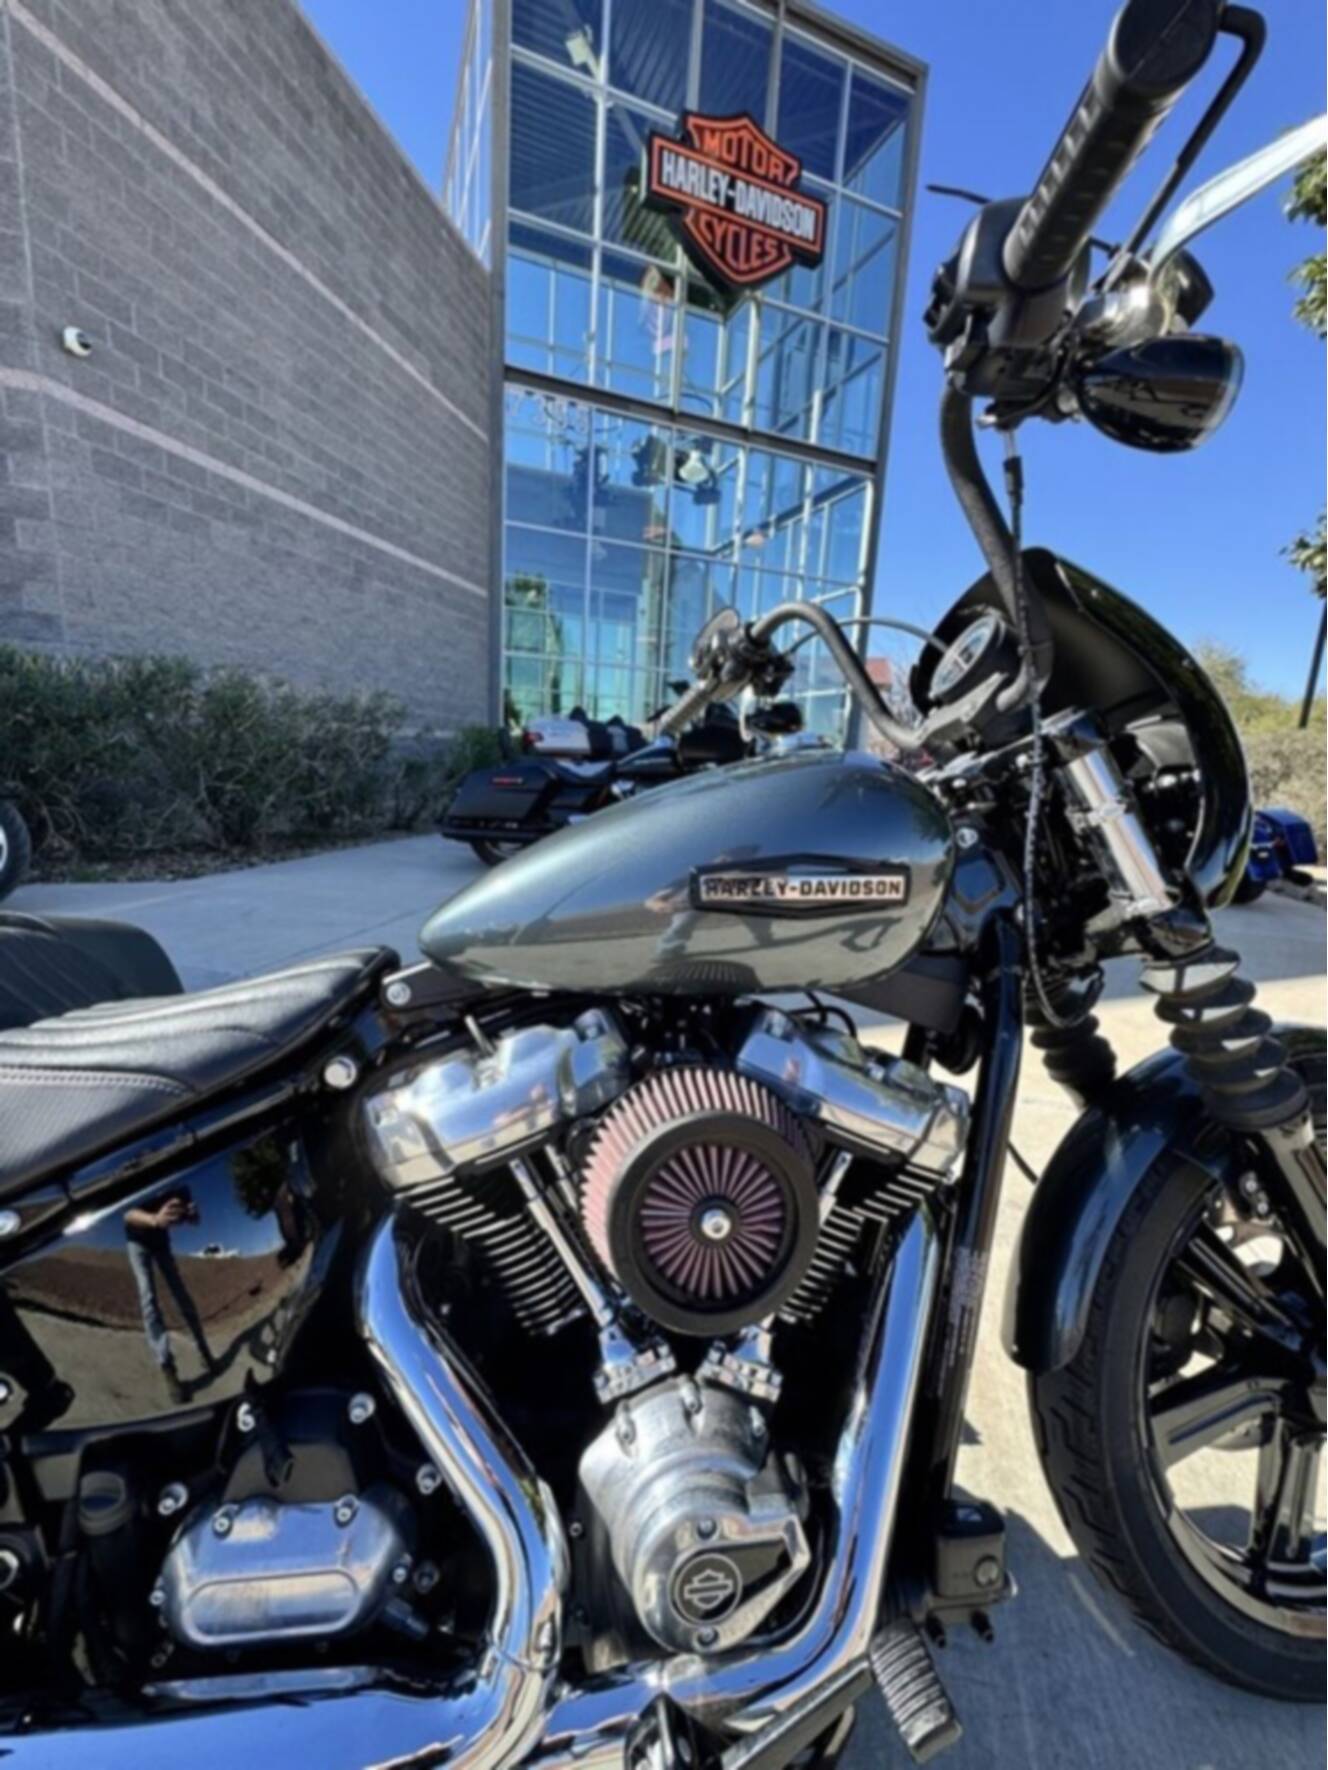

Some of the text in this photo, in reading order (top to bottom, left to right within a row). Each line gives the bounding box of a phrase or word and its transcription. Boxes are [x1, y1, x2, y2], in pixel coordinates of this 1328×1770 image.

[702, 128, 785, 184] MOTOR
[660, 149, 817, 242] HARLEY-DAVIDSON
[699, 210, 780, 272] CYCLES
